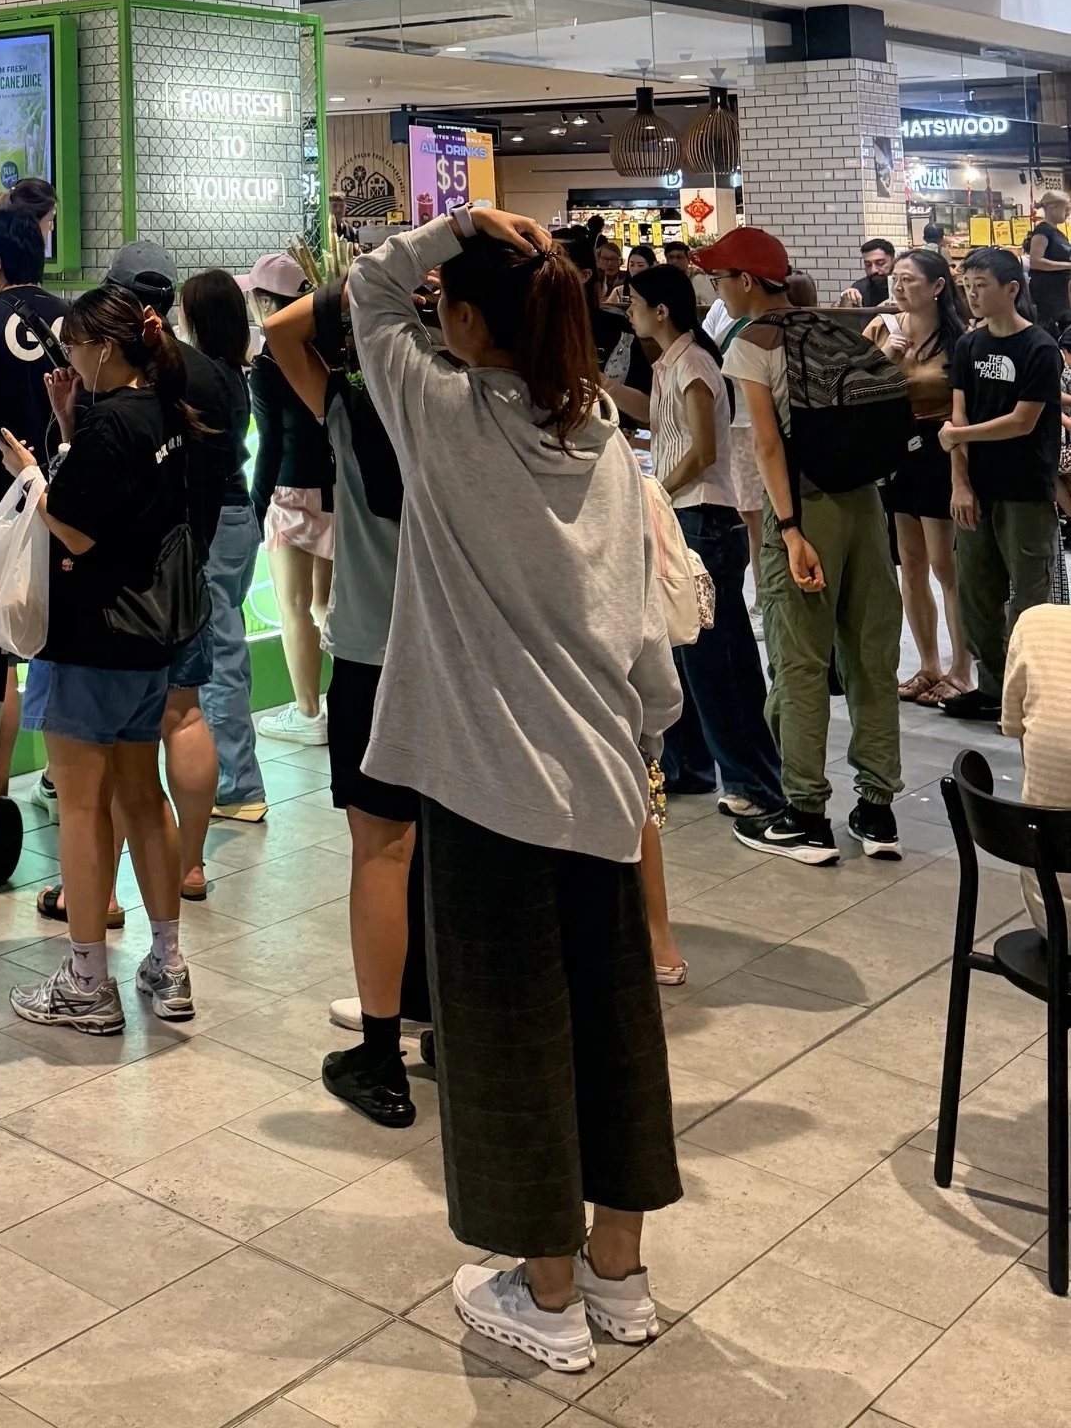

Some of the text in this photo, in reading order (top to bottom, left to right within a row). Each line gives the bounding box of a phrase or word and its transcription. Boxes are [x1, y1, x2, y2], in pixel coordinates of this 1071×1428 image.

[7, 64, 27, 74] FRESH
[181, 89, 283, 117] FARM FRESH
[899, 117, 1009, 138] HATSWOOD
[216, 135, 245, 158] TO
[421, 142, 487, 159] ALL DRINKS
[437, 154, 467, 194] $5
[193, 177, 279, 202] YOUR CUP
[1045, 178, 1061, 190] EGGS
[974, 360, 1001, 372] NORTH
[988, 354, 1003, 364] THE
[979, 370, 1001, 380] FACE
